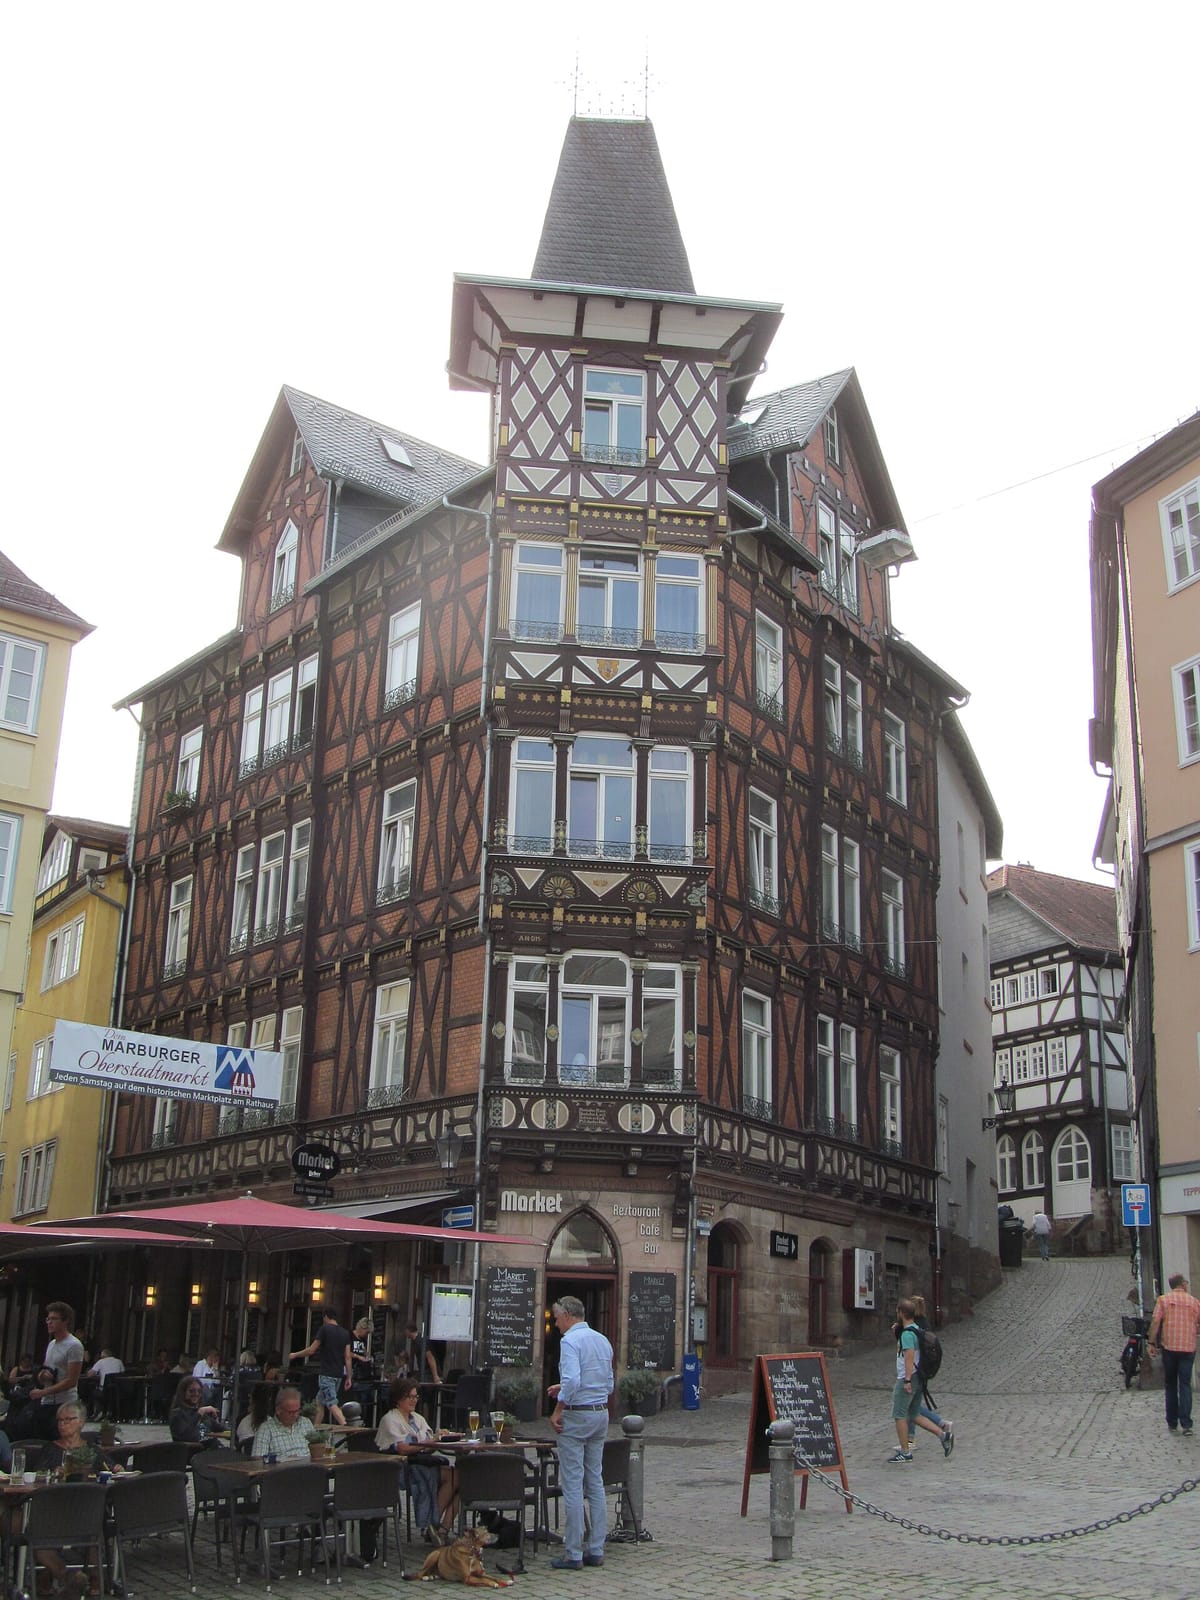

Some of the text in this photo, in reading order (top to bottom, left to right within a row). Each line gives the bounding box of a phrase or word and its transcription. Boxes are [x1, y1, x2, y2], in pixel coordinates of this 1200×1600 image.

[102, 1038, 201, 1064] MARBURGER
[78, 1049, 210, 1086] Oberstadtmarkt
[54, 1072, 274, 1110] Jeden Samstag auf dem historischen Marktplatz am Rathaus
[297, 1151, 335, 1170] Market
[501, 1190, 563, 1213] Market
[613, 1204, 661, 1218] Restaurant
[640, 1223, 660, 1236] Café
[644, 1243, 660, 1254] Bar
